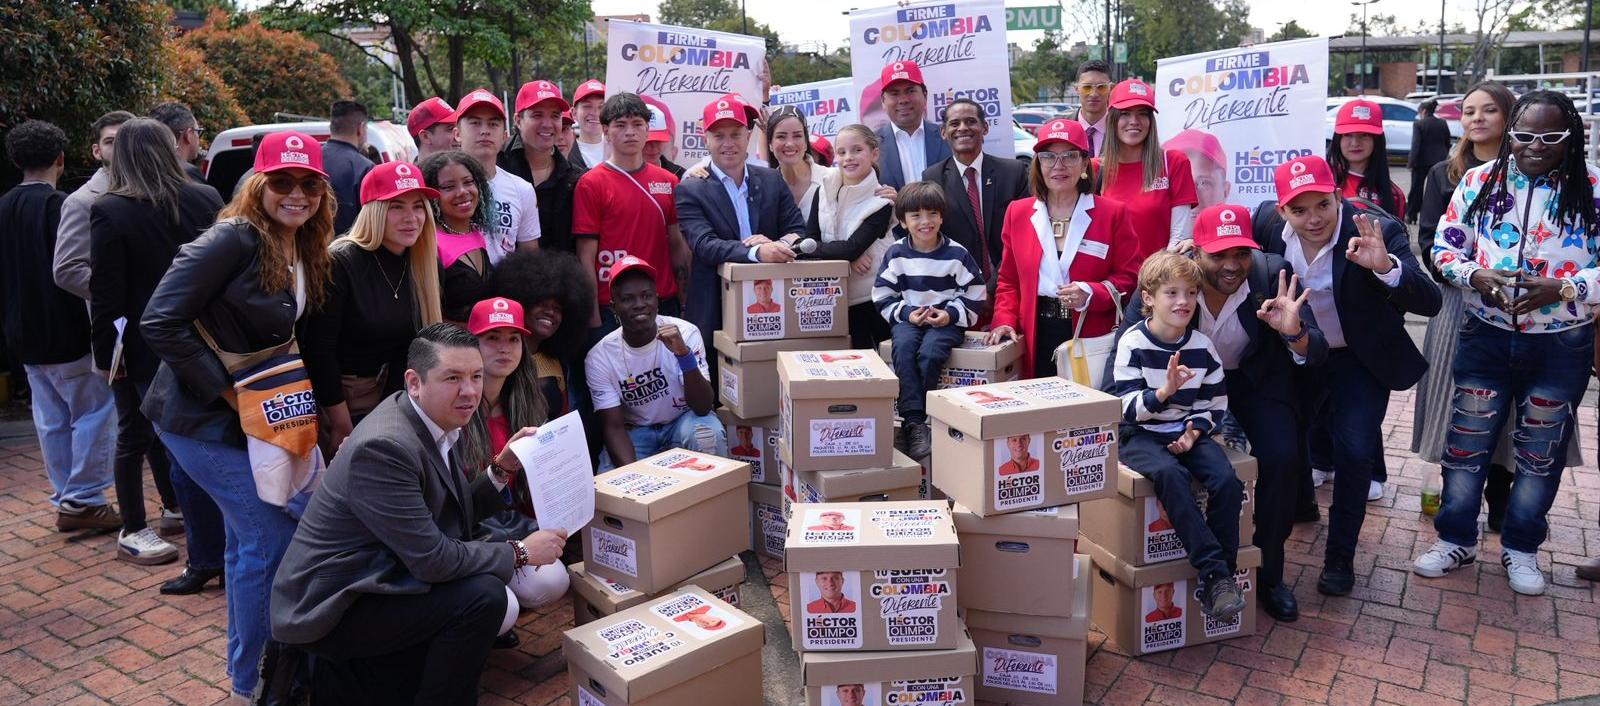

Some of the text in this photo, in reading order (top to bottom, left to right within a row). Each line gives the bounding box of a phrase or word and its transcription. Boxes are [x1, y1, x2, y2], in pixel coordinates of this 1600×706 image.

[905, 5, 948, 21] FIRME
[863, 15, 992, 45] COLOMBIA
[666, 32, 708, 47] FIRME
[621, 43, 750, 69] COLOMBIA
[1215, 53, 1260, 70] FIRME
[1168, 64, 1309, 97] COLOMBIA
[776, 90, 813, 104] FIRME
[801, 98, 851, 117] MBIA
[790, 287, 841, 297] COLOMBIA
[747, 314, 781, 324] HÉCTOR
[800, 309, 831, 318] HÉCTOR
[801, 316, 832, 325] OLIMPO
[747, 323, 781, 332] OLIMPO
[262, 390, 313, 411] HÉCTO
[1054, 432, 1114, 450] COLOMBIA
[1066, 464, 1103, 477] HÉCTOR
[998, 475, 1040, 489] HÉCTOR
[1067, 472, 1104, 487] OLIMPO
[999, 485, 1040, 500] OLIMPO
[1068, 483, 1103, 493] PRESIDENTE
[1000, 496, 1038, 506] PRESIDENTE
[1148, 540, 1184, 553] OLIMPO
[1149, 550, 1183, 559] PRESIDENTE
[872, 583, 948, 596] COLOMBIA
[883, 594, 938, 615] Diferente
[807, 615, 857, 627] HÉCTOR
[889, 614, 934, 625] HÉCTOR
[808, 628, 857, 638] OLIMPO
[890, 625, 934, 636] OLIMPO
[1145, 621, 1182, 634] HÉCTOR
[1145, 630, 1181, 643] OLIMPO
[1146, 639, 1180, 649] PRESIDENTE
[993, 657, 1046, 674] Diferente
[888, 690, 963, 703] COLOMBIA
